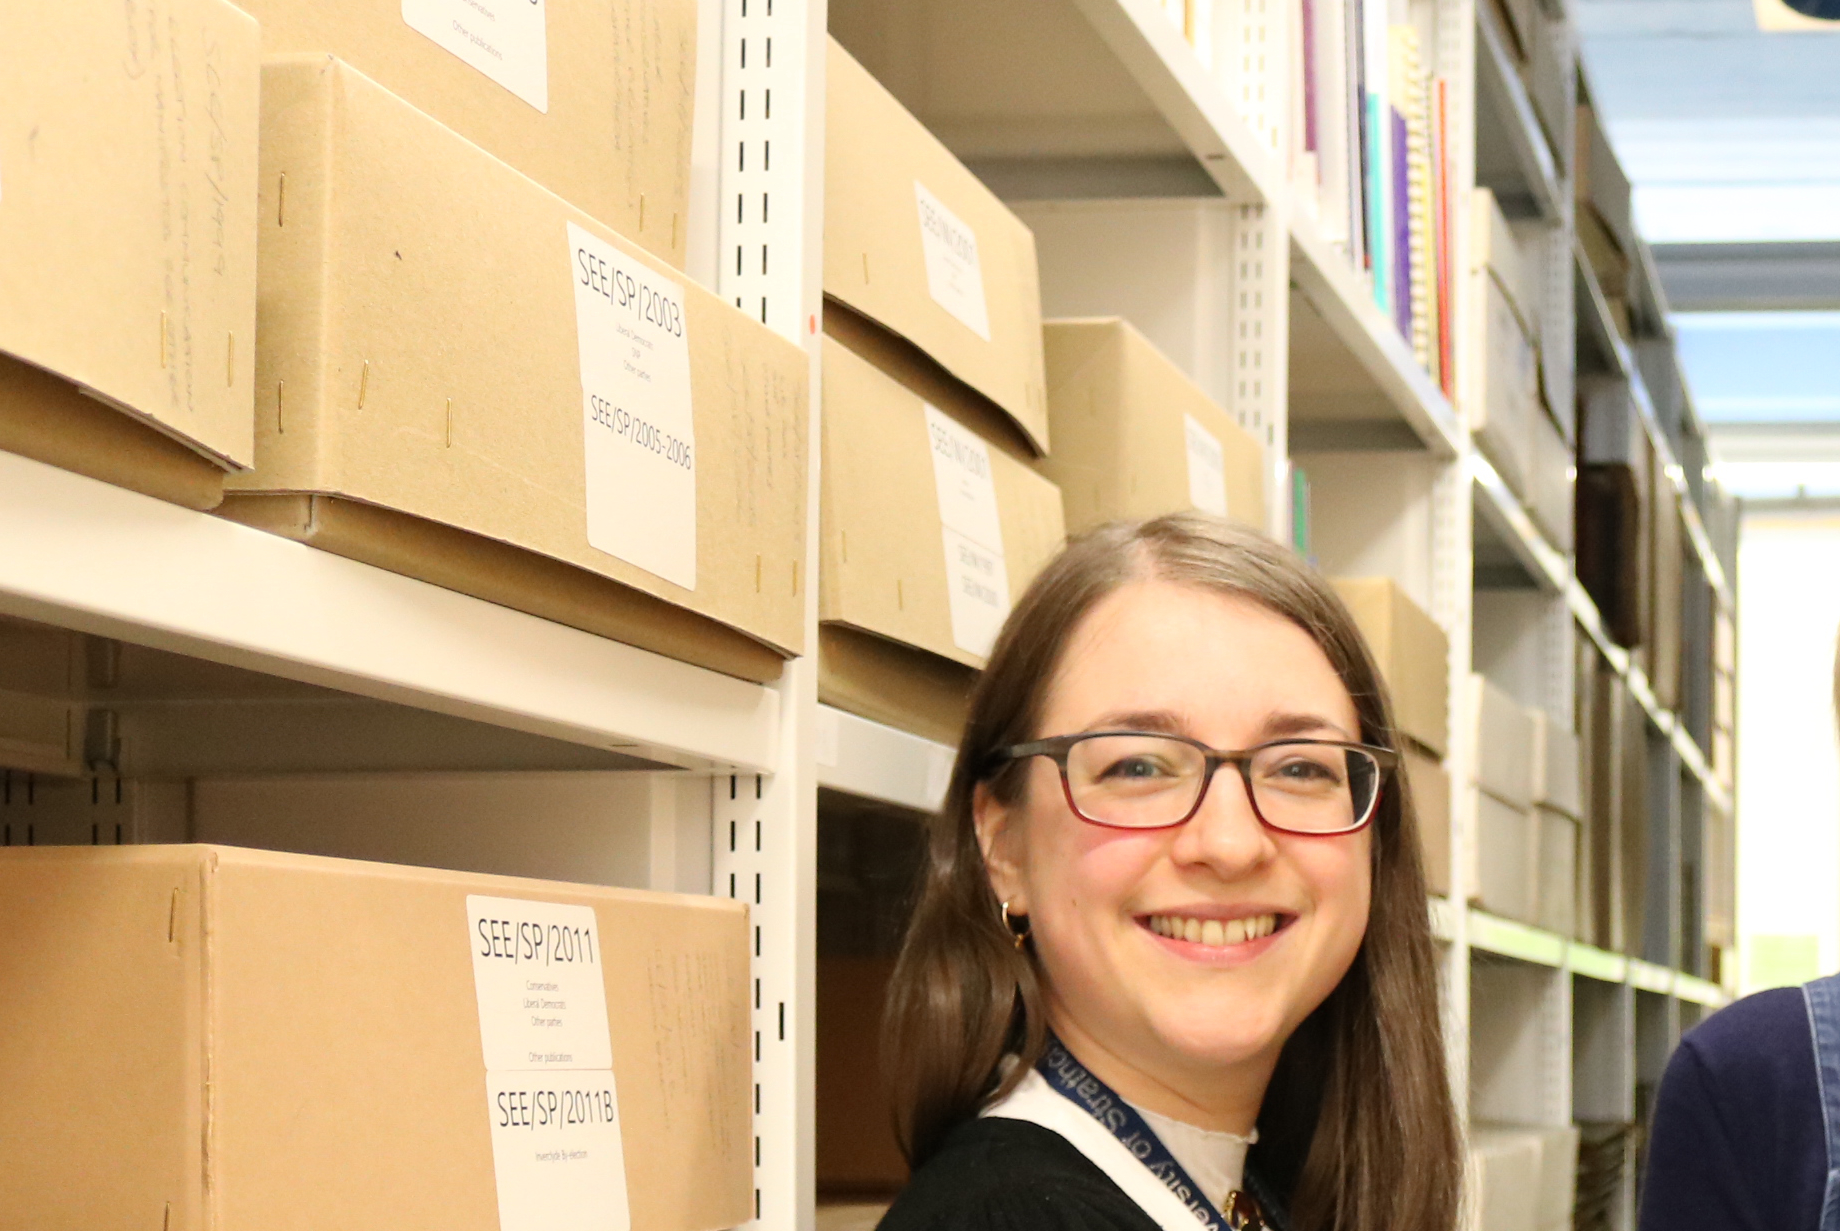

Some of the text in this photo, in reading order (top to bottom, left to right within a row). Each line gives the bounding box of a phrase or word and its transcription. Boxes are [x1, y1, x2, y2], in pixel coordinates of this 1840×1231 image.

[577, 248, 682, 338] SEE/SP/2003
[590, 394, 692, 471] SEE/SP/2005-2006
[478, 917, 595, 967] SEE/SP/2011
[526, 979, 559, 993] Conservatives
[522, 997, 567, 1011] Liberal Democrats
[531, 1015, 563, 1030] Other parties
[528, 1051, 573, 1066] Other publications
[497, 1089, 615, 1131] SEE/SP/2011B
[535, 1149, 562, 1163] Inverclyde
